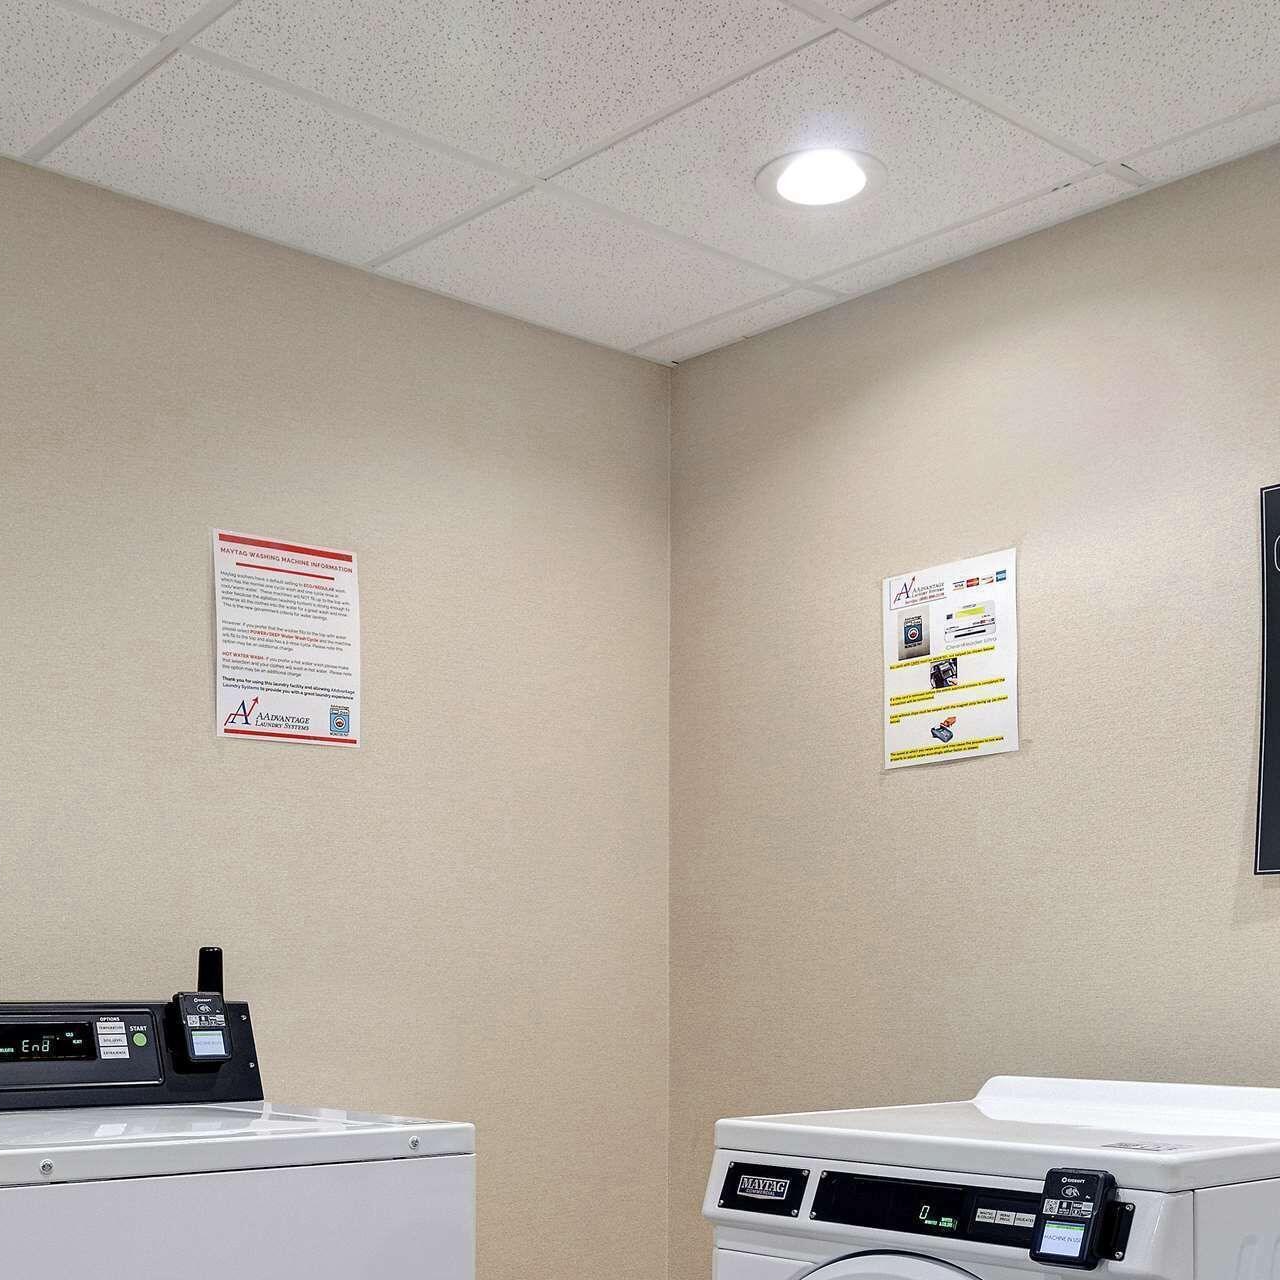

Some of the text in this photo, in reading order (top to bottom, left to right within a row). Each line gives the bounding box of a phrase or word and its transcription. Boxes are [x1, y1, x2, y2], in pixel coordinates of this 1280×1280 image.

[221, 547, 352, 573] MAYTAG WASHING MACHINE INFORMATION
[22, 1040, 50, 1052] End
[741, 1178, 786, 1193] MAYTAG
